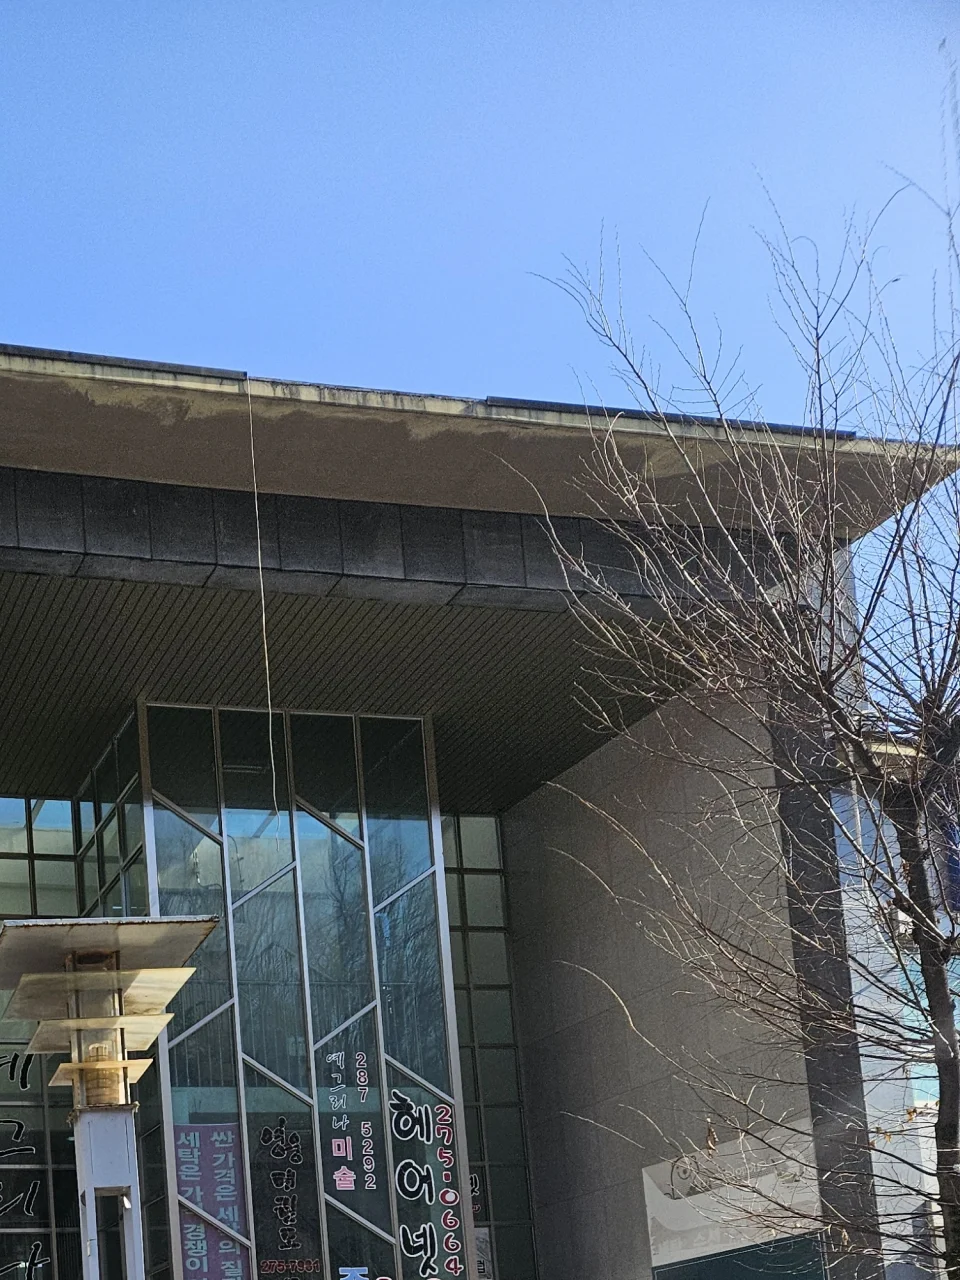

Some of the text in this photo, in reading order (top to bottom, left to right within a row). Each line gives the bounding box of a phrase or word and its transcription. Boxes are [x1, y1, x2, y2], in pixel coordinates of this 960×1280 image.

[210, 1131, 236, 1148] 싼
[355, 1052, 377, 1190] 287 5292
[177, 1131, 202, 1181] 세탁은
[212, 1153, 238, 1201] 가격은
[331, 1136, 356, 1191] 미술
[389, 1089, 439, 1278] 헤어넷
[183, 1223, 208, 1273] 경쟁이
